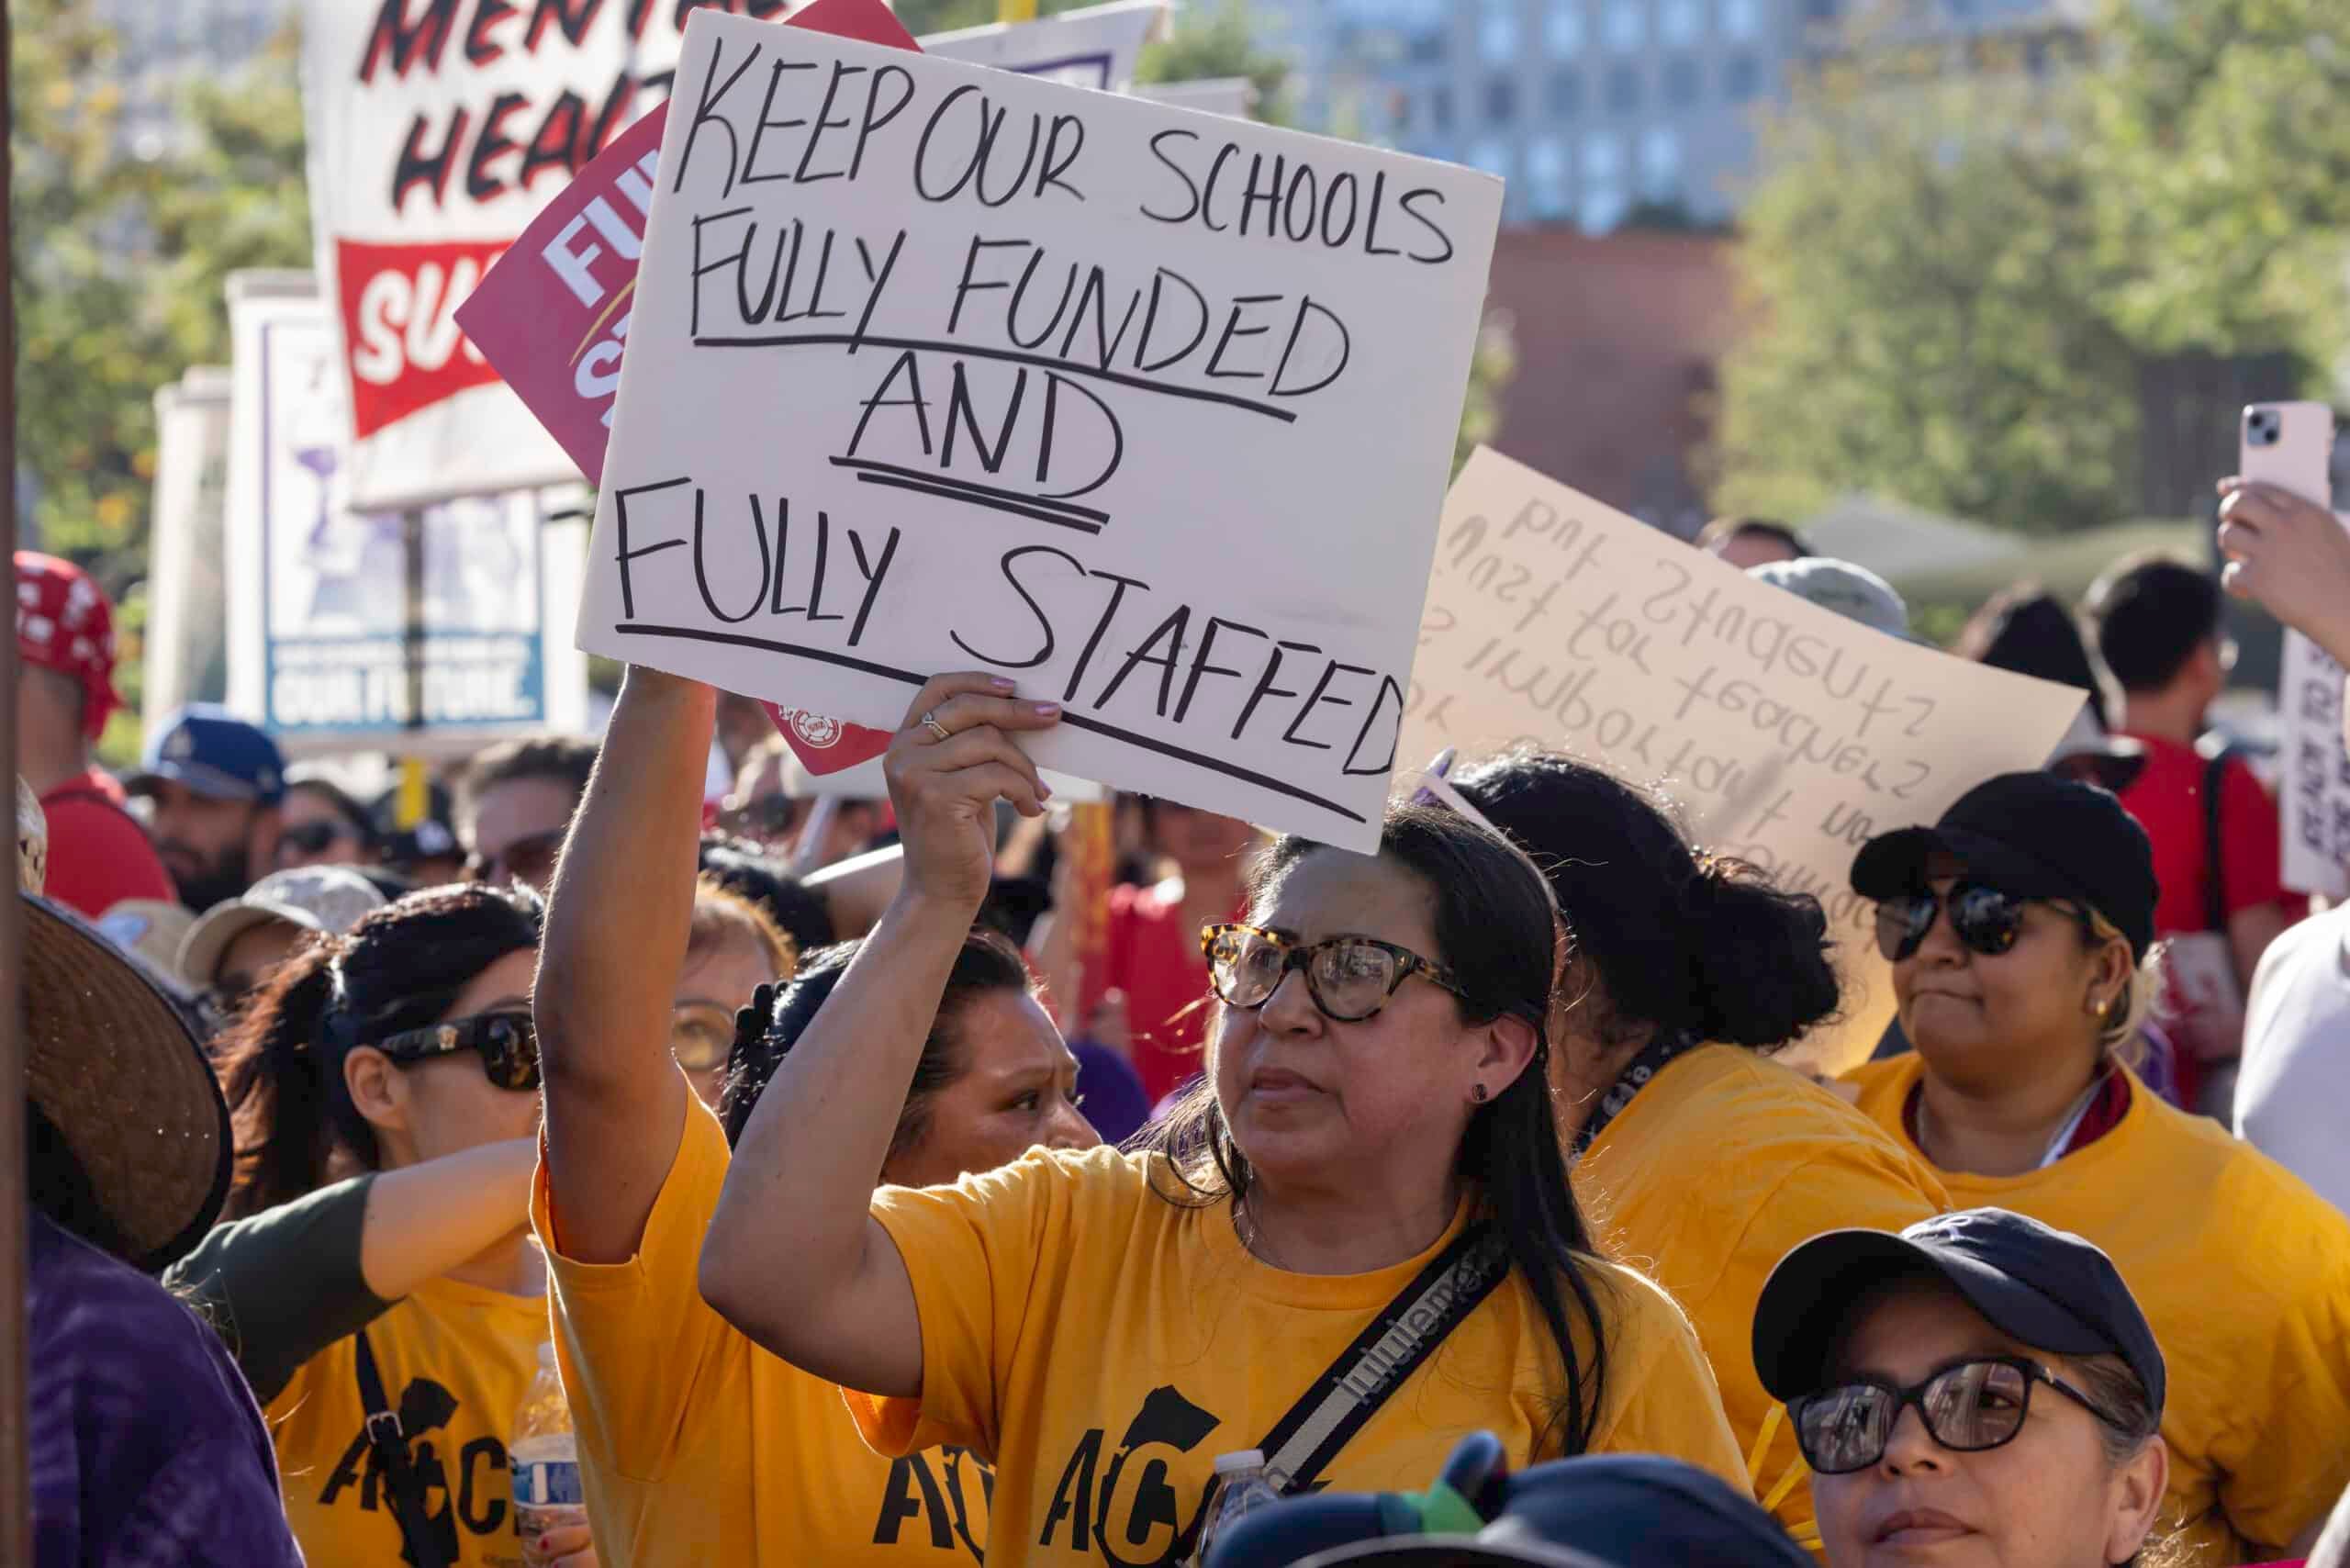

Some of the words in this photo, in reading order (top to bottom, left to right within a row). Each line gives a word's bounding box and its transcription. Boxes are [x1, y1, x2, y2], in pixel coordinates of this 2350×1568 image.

[672, 36, 914, 199] KEEP
[914, 84, 1085, 207] OUR
[1139, 129, 1454, 263] SCHOOLS
[690, 206, 907, 354] FULLY
[947, 234, 1350, 397] FUNDED
[847, 350, 1123, 498] AND
[614, 476, 901, 646] FULLY
[950, 544, 1404, 776] STAFFED
